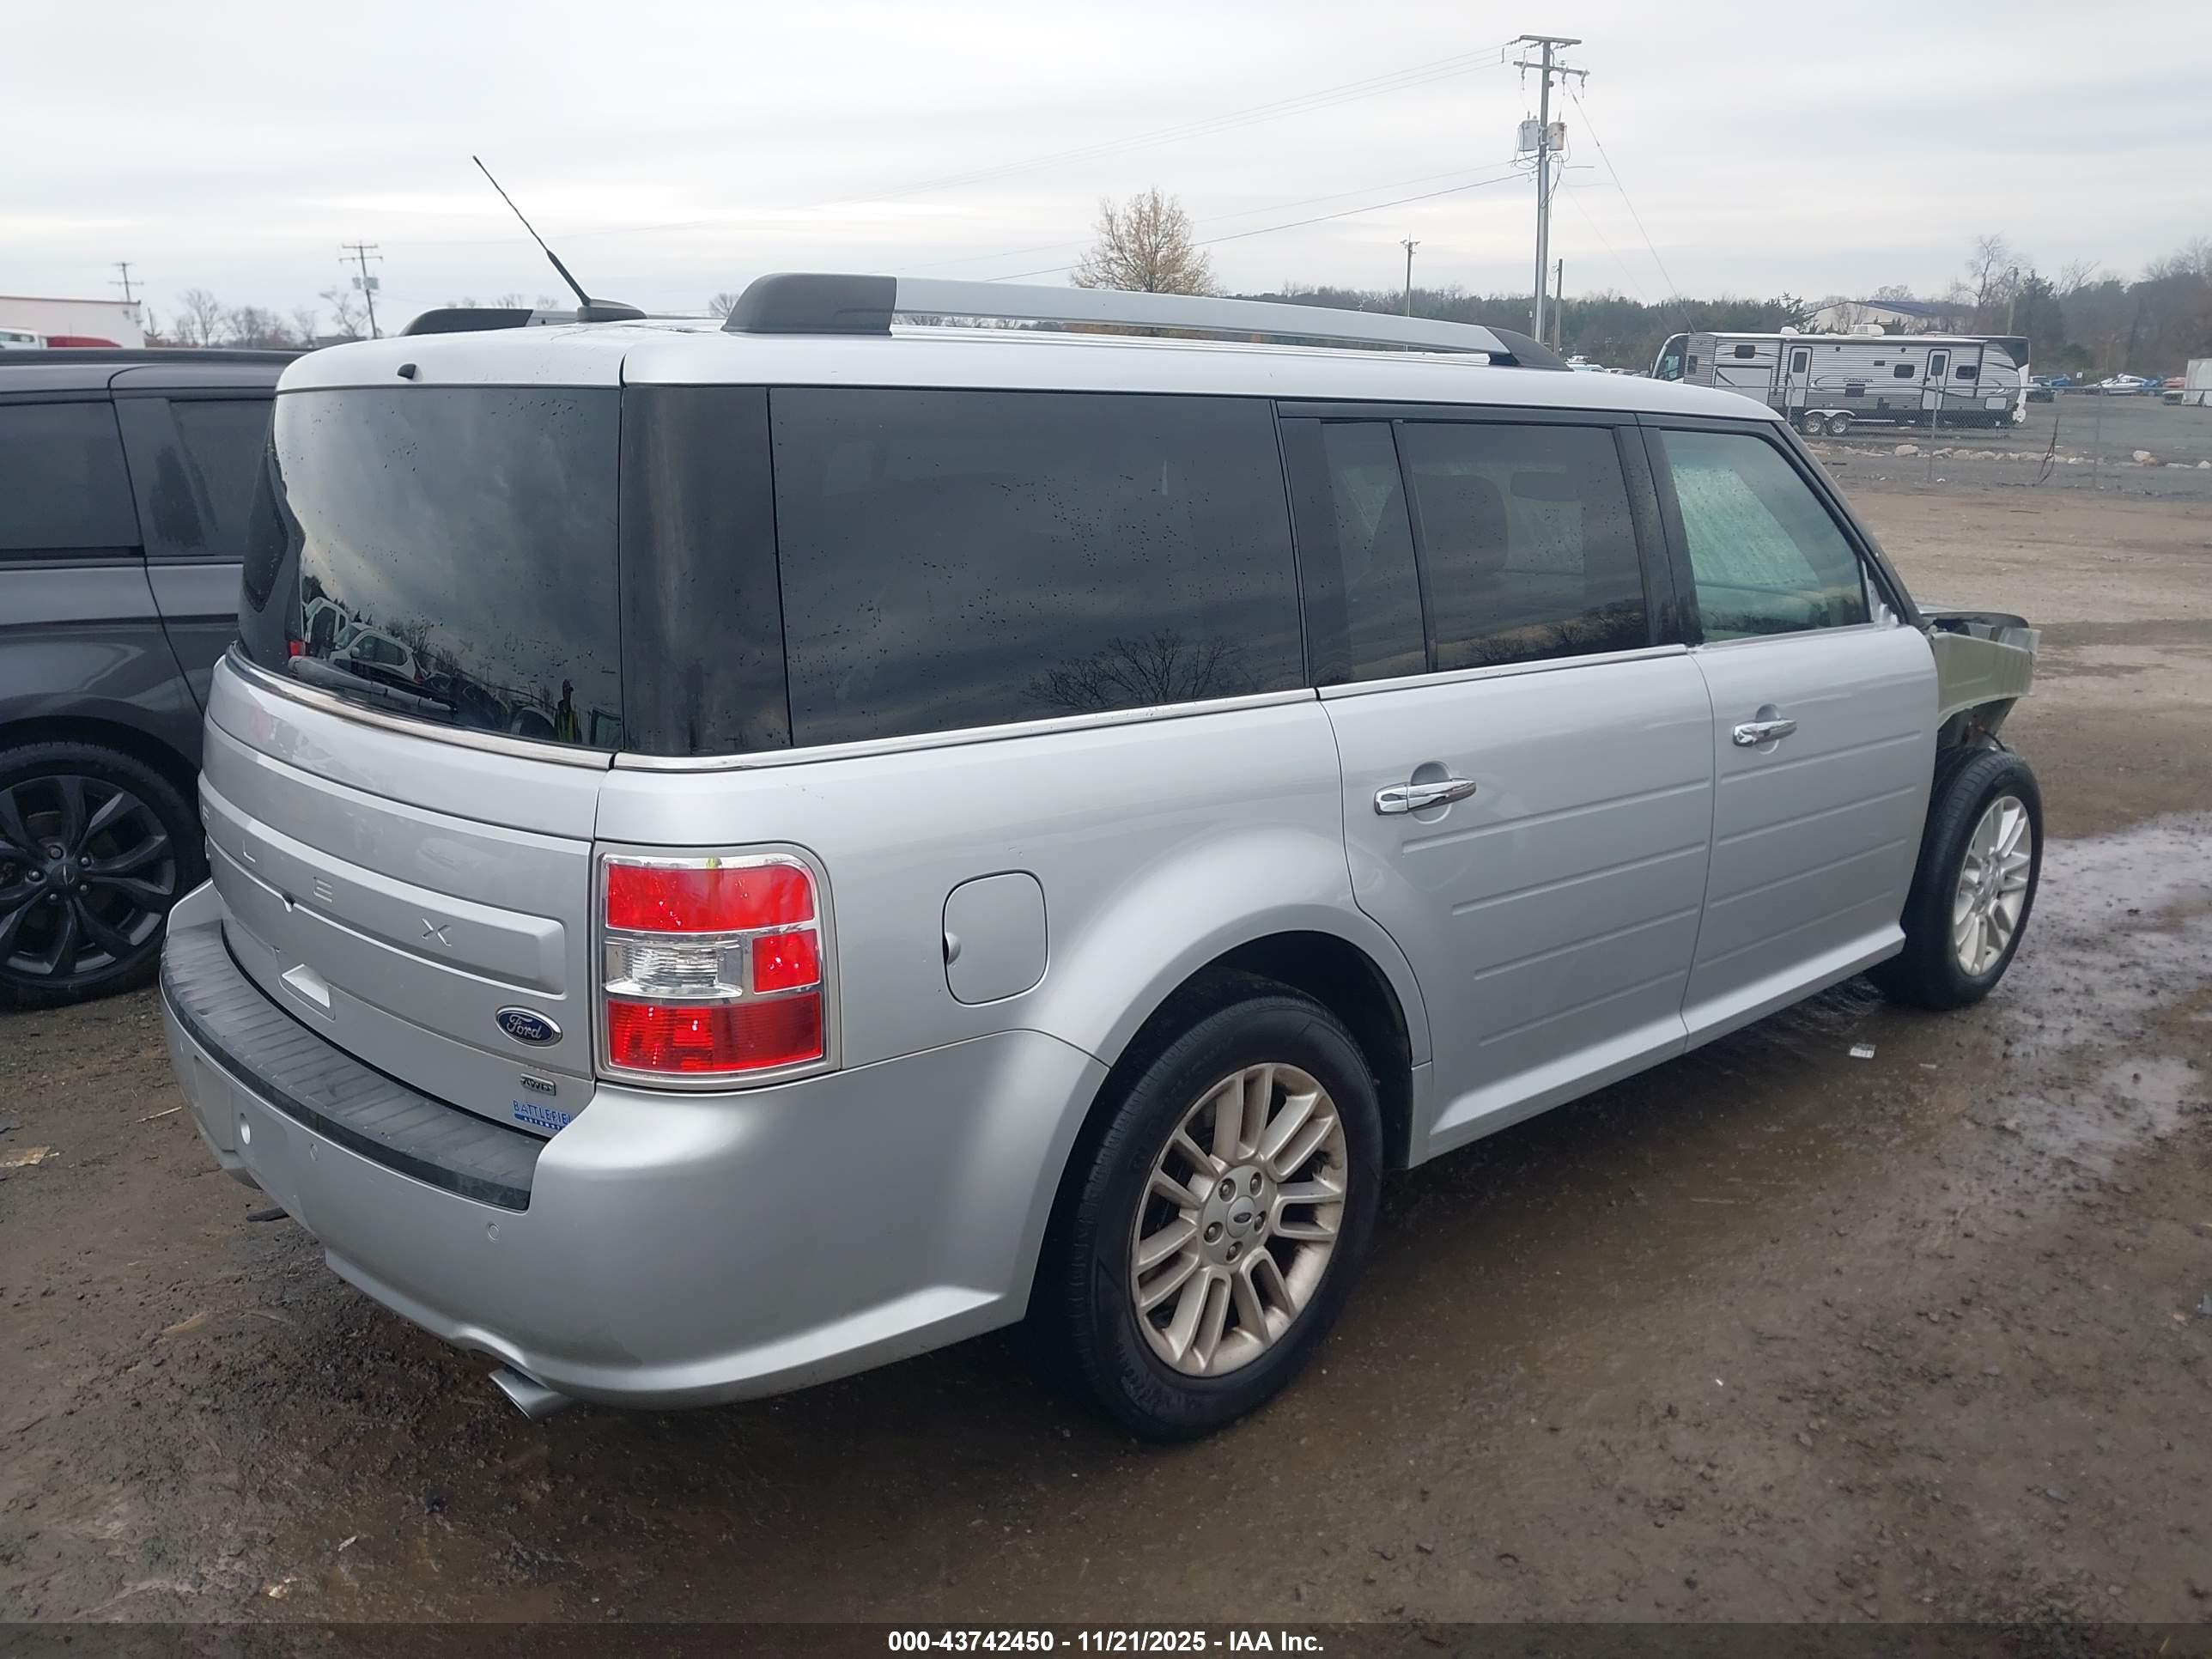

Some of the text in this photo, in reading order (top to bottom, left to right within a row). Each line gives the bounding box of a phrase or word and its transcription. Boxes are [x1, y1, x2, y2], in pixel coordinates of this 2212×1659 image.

[202, 804, 453, 947] FLEX
[506, 1013, 543, 1040] Ford
[520, 1076, 552, 1092] AWD
